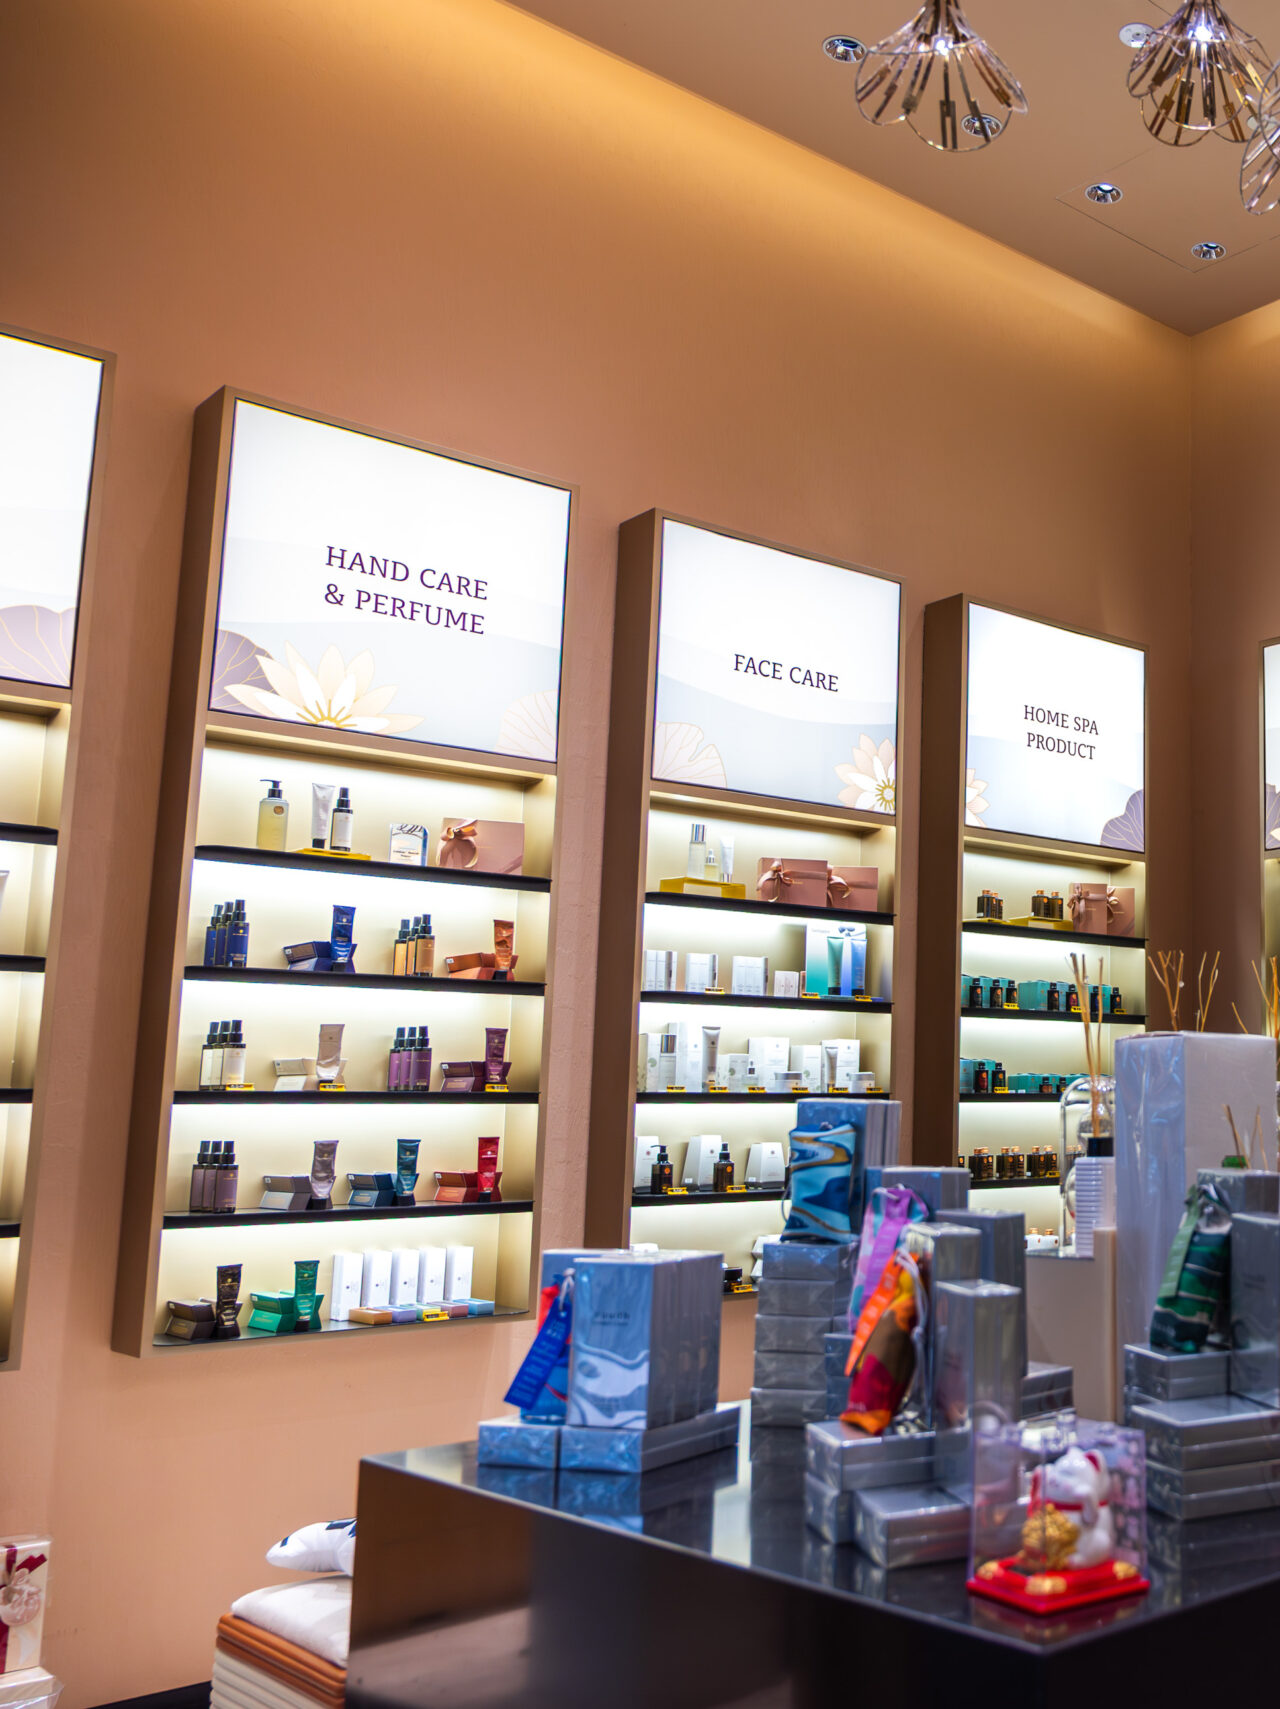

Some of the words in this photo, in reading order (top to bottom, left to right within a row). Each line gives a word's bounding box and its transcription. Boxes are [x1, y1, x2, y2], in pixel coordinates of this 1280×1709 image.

[325, 545, 410, 582] HAND
[419, 568, 488, 601] CARE
[324, 583, 345, 606] &
[354, 589, 485, 635] PERFUME
[733, 653, 783, 680] FACE
[789, 666, 839, 692] CARE
[1024, 704, 1069, 729] HOME
[1073, 716, 1099, 735] SPA
[1026, 731, 1096, 760] PRODUCT
